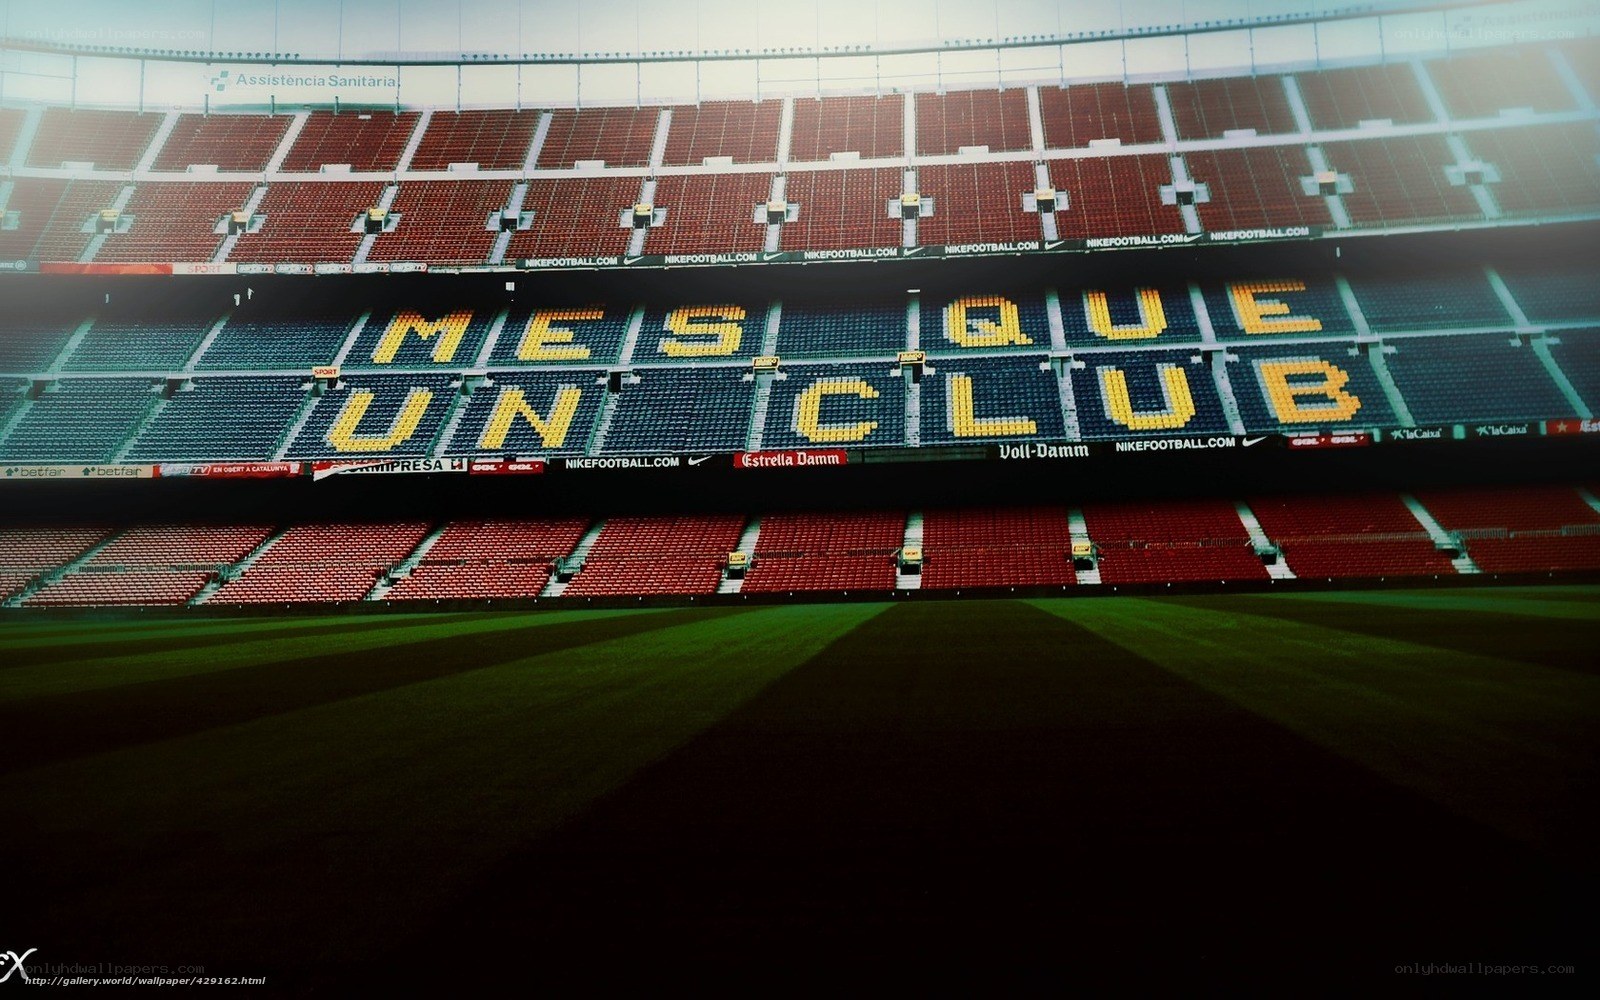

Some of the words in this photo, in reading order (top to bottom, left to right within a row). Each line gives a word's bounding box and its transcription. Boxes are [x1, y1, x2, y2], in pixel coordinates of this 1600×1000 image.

[236, 73, 325, 86] Assistència
[1211, 227, 1309, 240] NIKEFOOTBALL.COM
[1087, 235, 1184, 247] NIKEFOOTBALL.COM
[804, 248, 898, 260] NIKEFOOTBALL.COM
[945, 242, 1039, 254] NIKEFOOTBALL.COM
[525, 257, 618, 268] NIKEFOOTBALL.COM
[664, 253, 757, 264] NIKEFOOTBALL.COM
[187, 265, 222, 273] SPORT
[371, 304, 746, 363] MES
[942, 281, 1322, 347] QUE
[327, 382, 581, 452] UN
[791, 357, 1361, 443] CLUB
[1116, 437, 1236, 452] NIKEFOOTBALL.COM
[999, 444, 1090, 459] Voll-Damm
[565, 457, 680, 469] NIKEFOOTBALL.COM
[742, 452, 793, 466] Estrella
[797, 452, 840, 465] Damm
[20, 466, 66, 477] betfair
[97, 465, 142, 477] betfair
